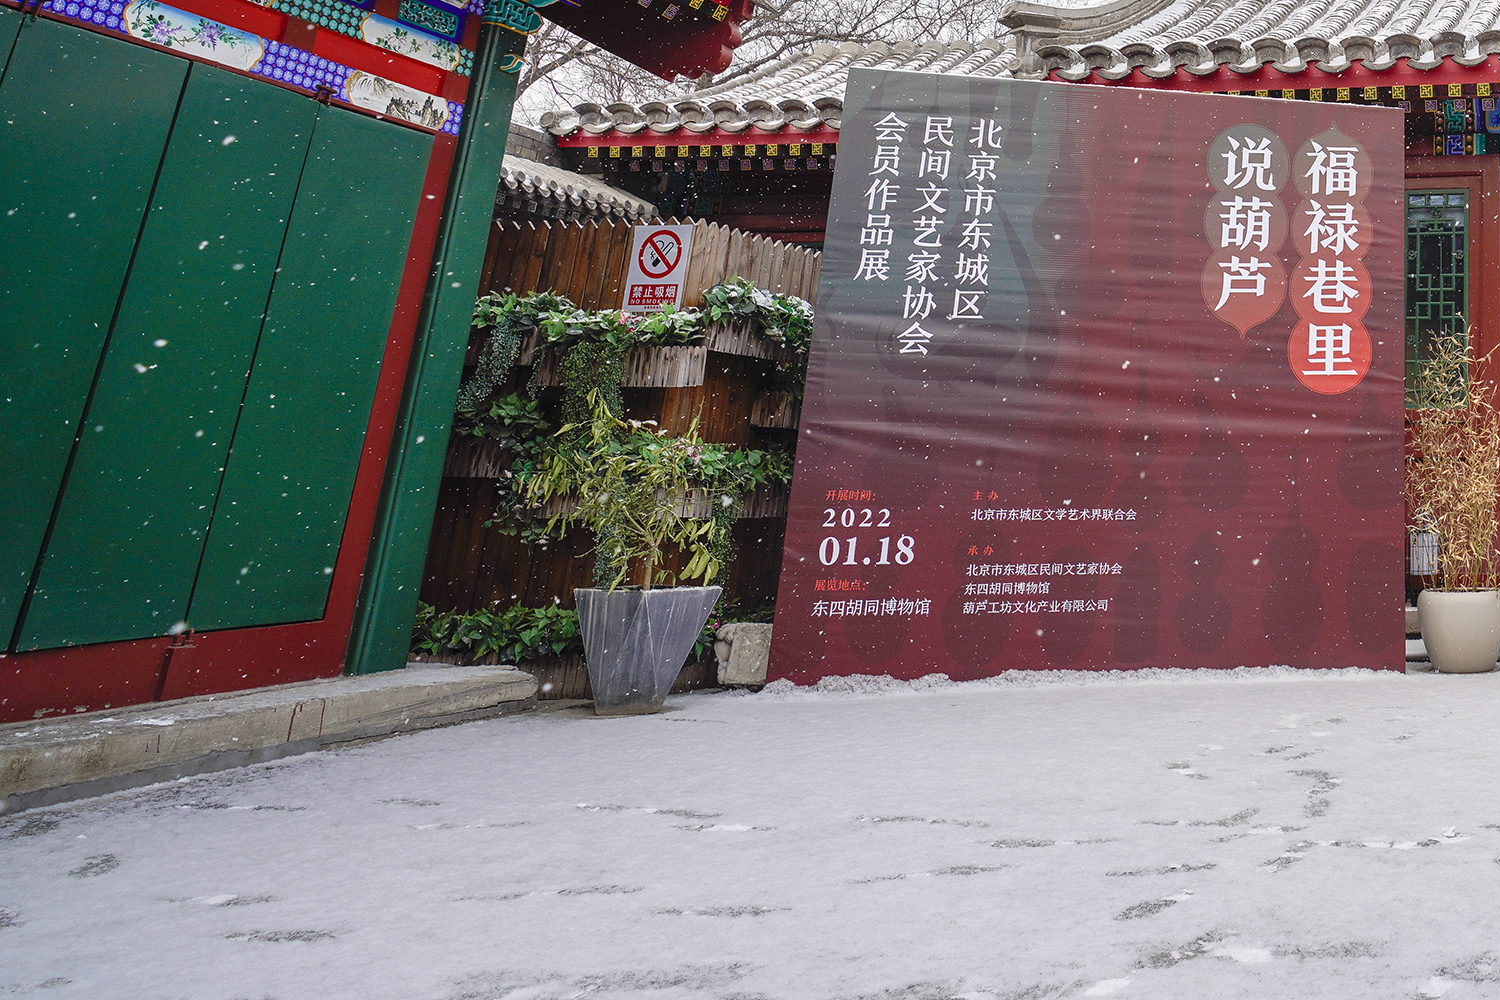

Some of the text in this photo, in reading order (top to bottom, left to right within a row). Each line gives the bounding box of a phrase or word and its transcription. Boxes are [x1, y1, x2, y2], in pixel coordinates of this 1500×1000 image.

[853, 111, 909, 282] 会员作品展
[952, 118, 1003, 320] 北京市东城区
[1214, 135, 1277, 312] 说葫芦
[897, 115, 955, 356] 民间文艺家协会
[1301, 140, 1360, 376] 福禄巷里
[632, 286, 676, 298] 禁止吸烟
[822, 508, 891, 527] 2022
[971, 508, 1137, 521] 北京市东城区文学艺术界联合会
[819, 535, 915, 565] 01.18
[966, 562, 1122, 576] 北京市东城区民间文艺家协会
[964, 581, 1051, 595] 东四胡同博物馆
[811, 598, 931, 617] 东四胡同博物馆
[962, 599, 1109, 614] 葫芦工坊文化产业有限公司
